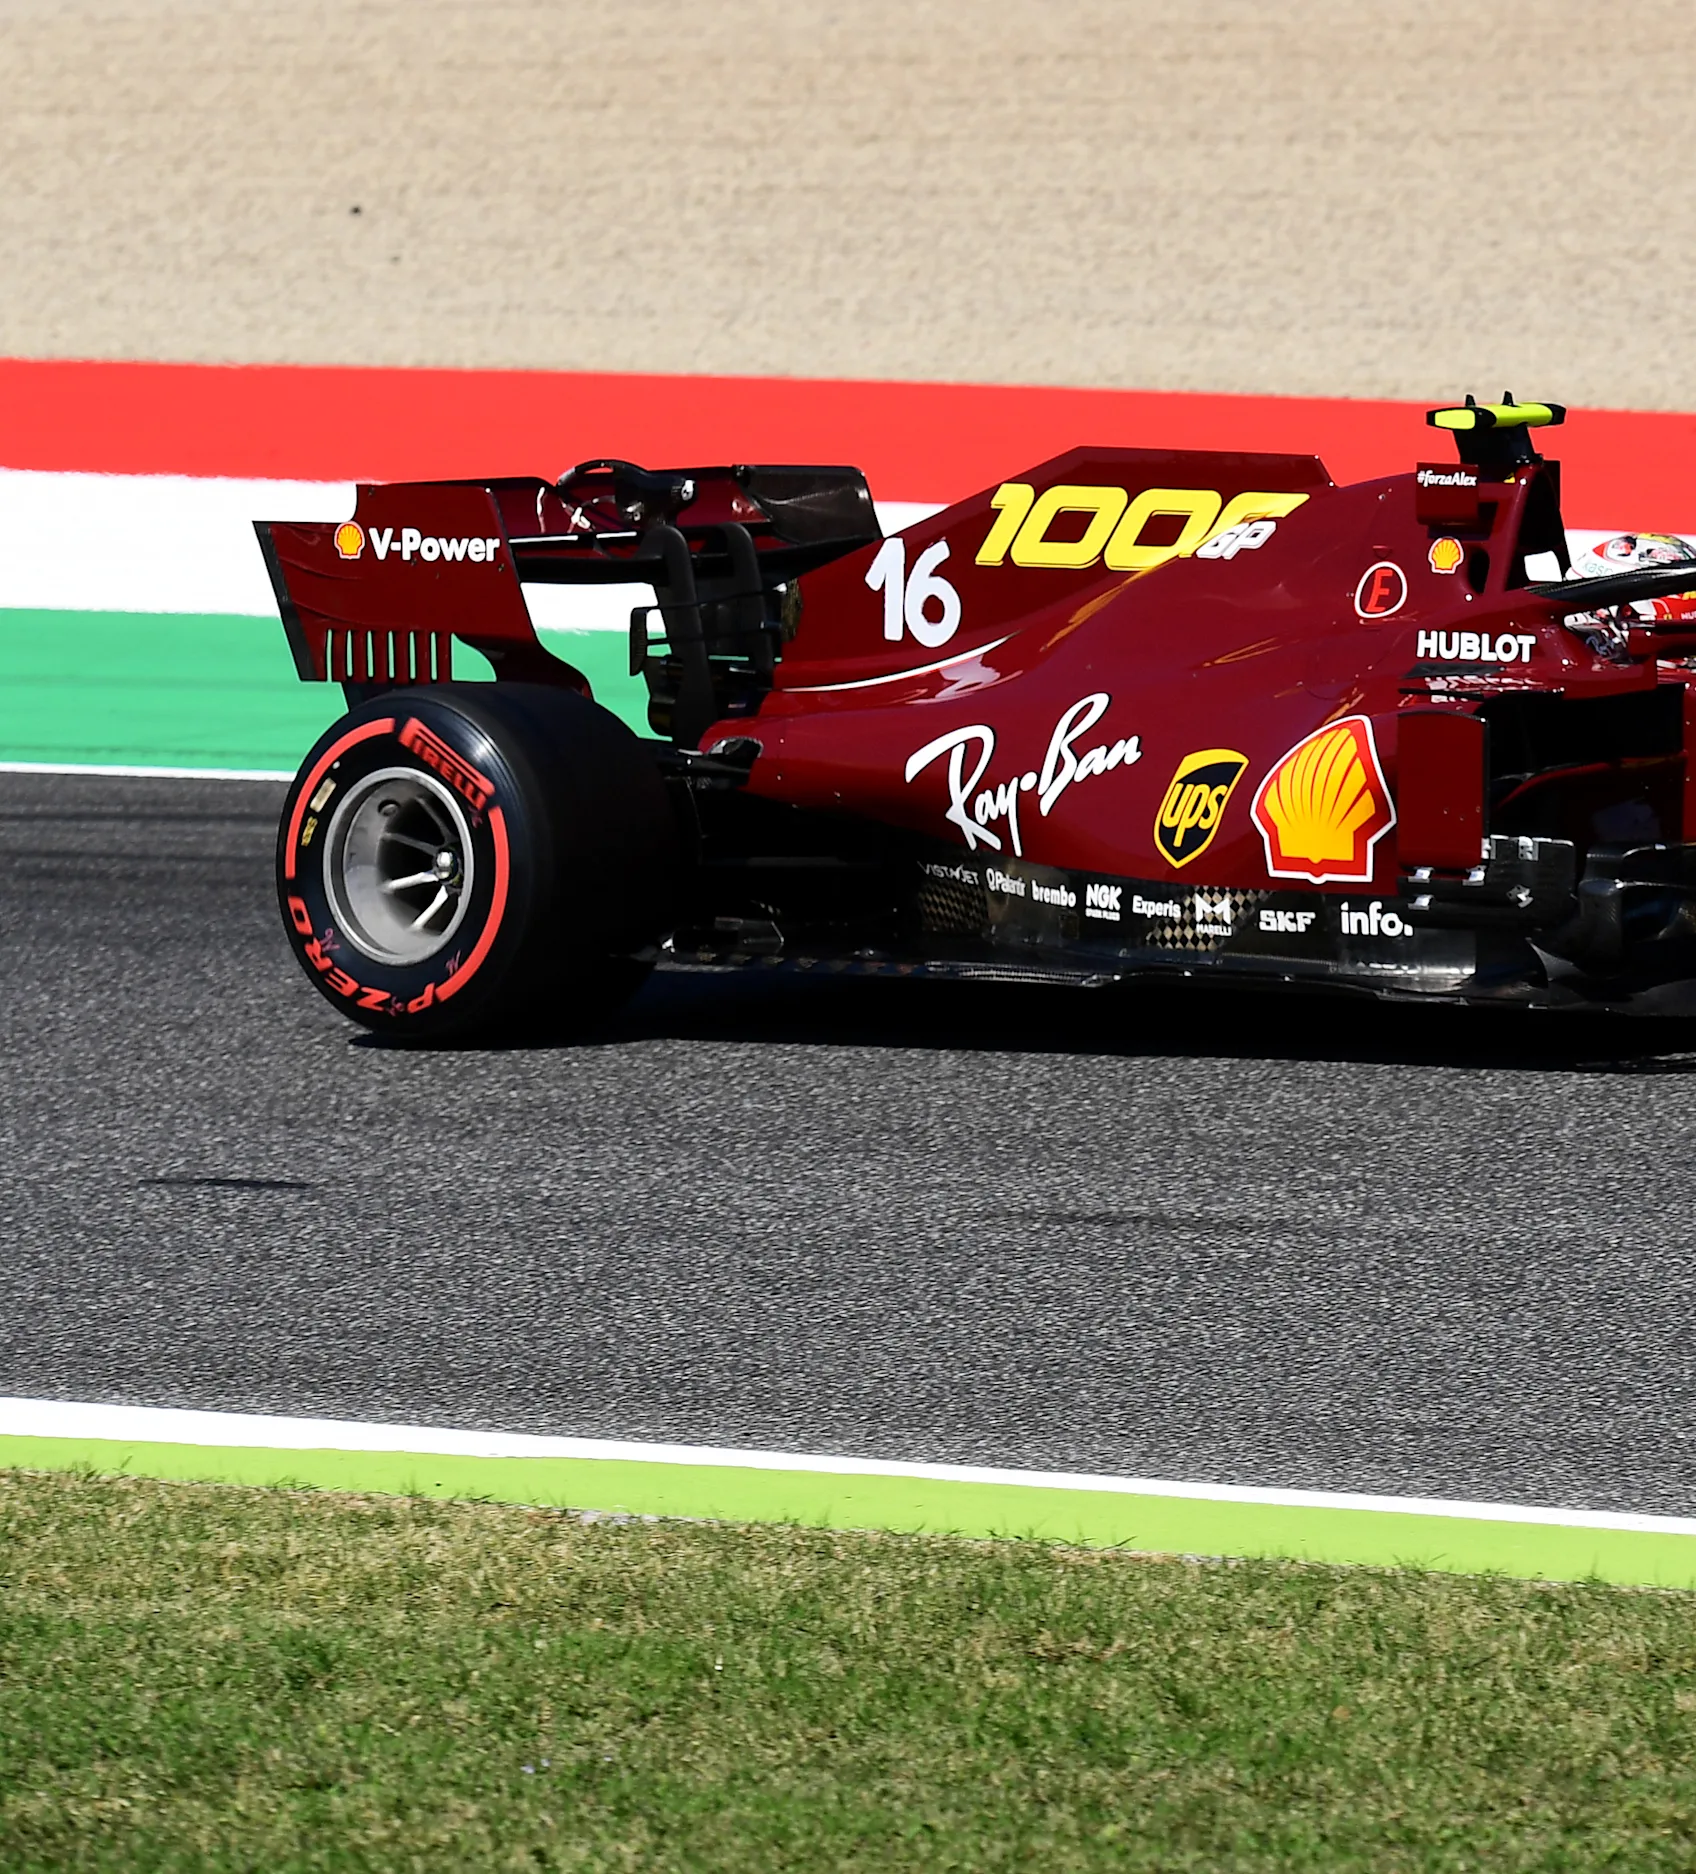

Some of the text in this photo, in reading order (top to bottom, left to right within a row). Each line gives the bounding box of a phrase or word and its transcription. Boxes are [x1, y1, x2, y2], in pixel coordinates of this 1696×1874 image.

[1417, 470, 1477, 487] #forzaAlex
[368, 527, 500, 562] V-Power
[1196, 520, 1276, 560] GP
[864, 536, 961, 648] 16
[1365, 568, 1394, 613] E
[1416, 630, 1536, 663] HUBLOT
[398, 717, 496, 811] PIRELLI
[1161, 783, 1229, 847] ups
[1031, 879, 1077, 907] brembo
[1086, 883, 1122, 911] NGK
[1132, 895, 1181, 918] Experis
[1259, 910, 1316, 932] SKF
[288, 895, 436, 1014] P ZERO
